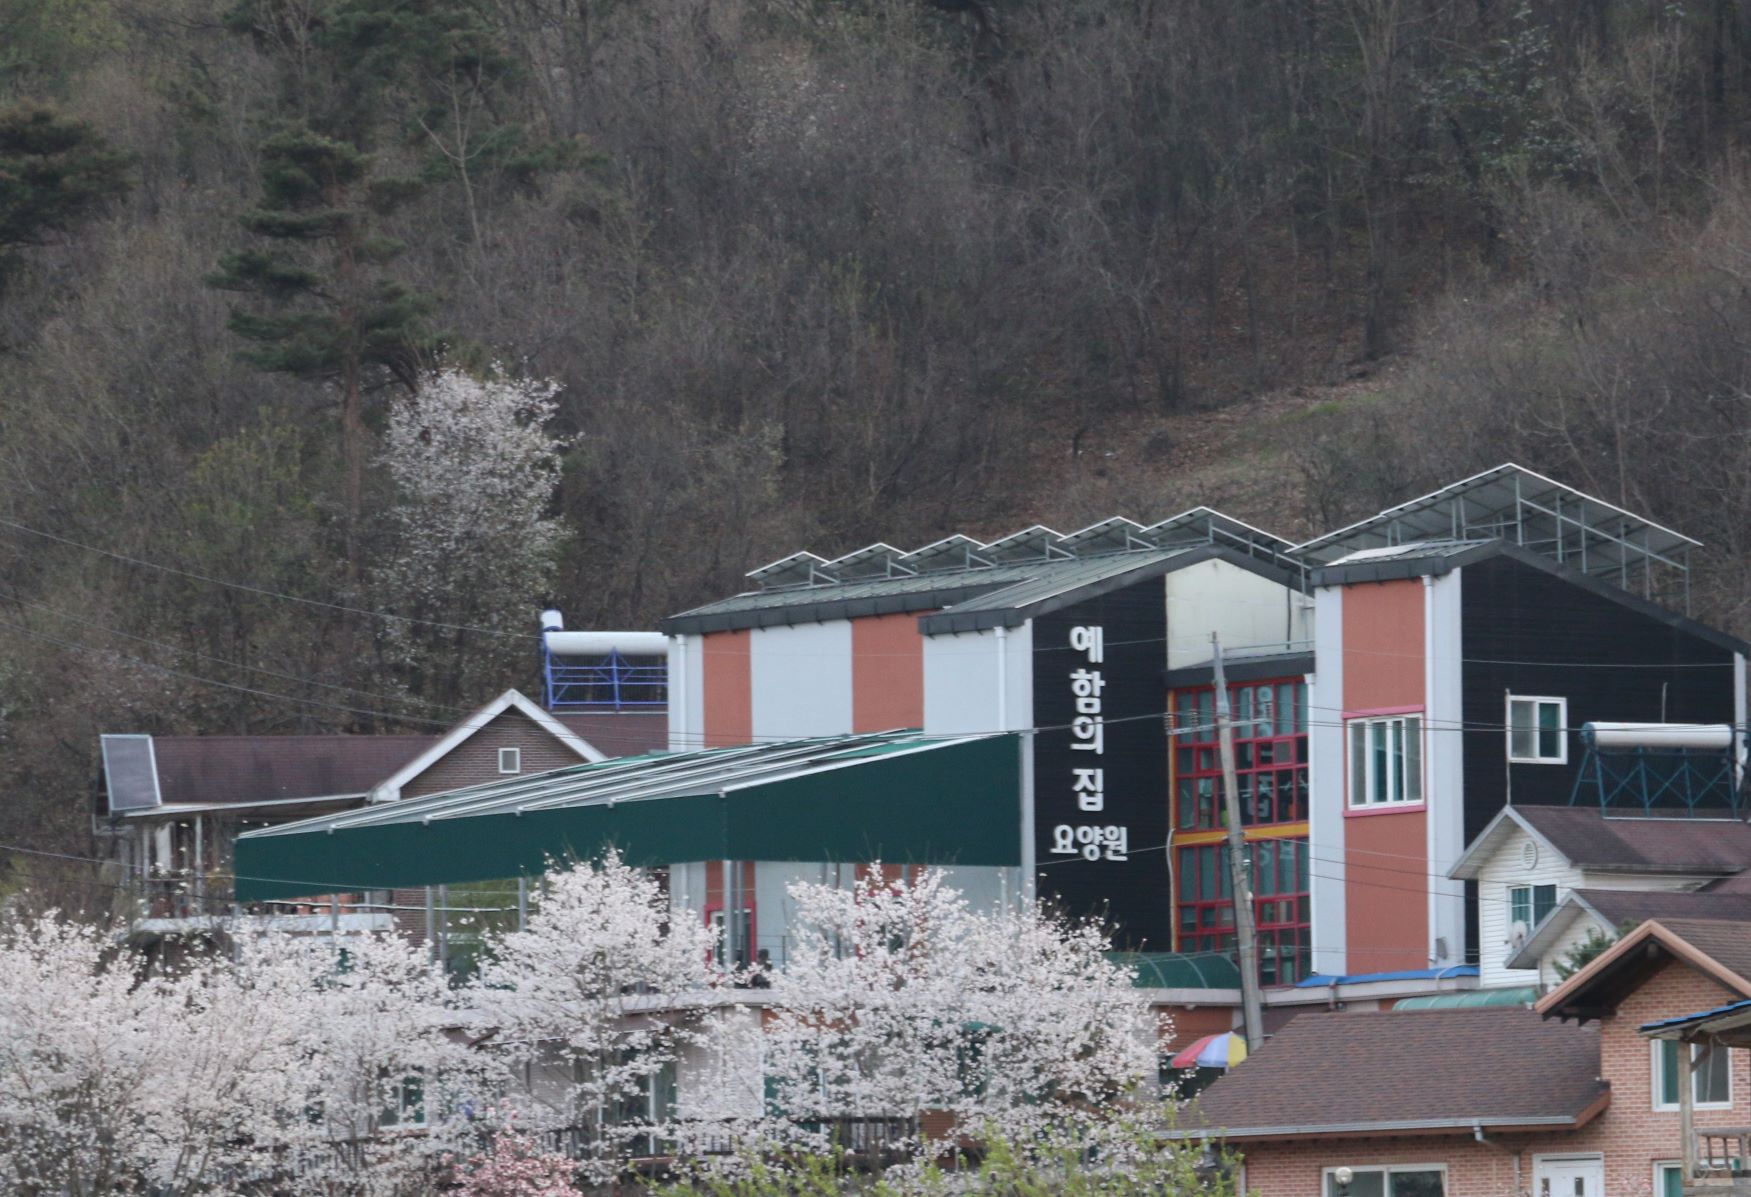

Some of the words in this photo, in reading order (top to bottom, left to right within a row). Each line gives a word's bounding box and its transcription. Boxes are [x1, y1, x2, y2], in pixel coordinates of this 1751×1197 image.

[1069, 625, 1105, 755] 예함의
[1072, 768, 1104, 812] 집
[1050, 824, 1128, 862] 요양원
